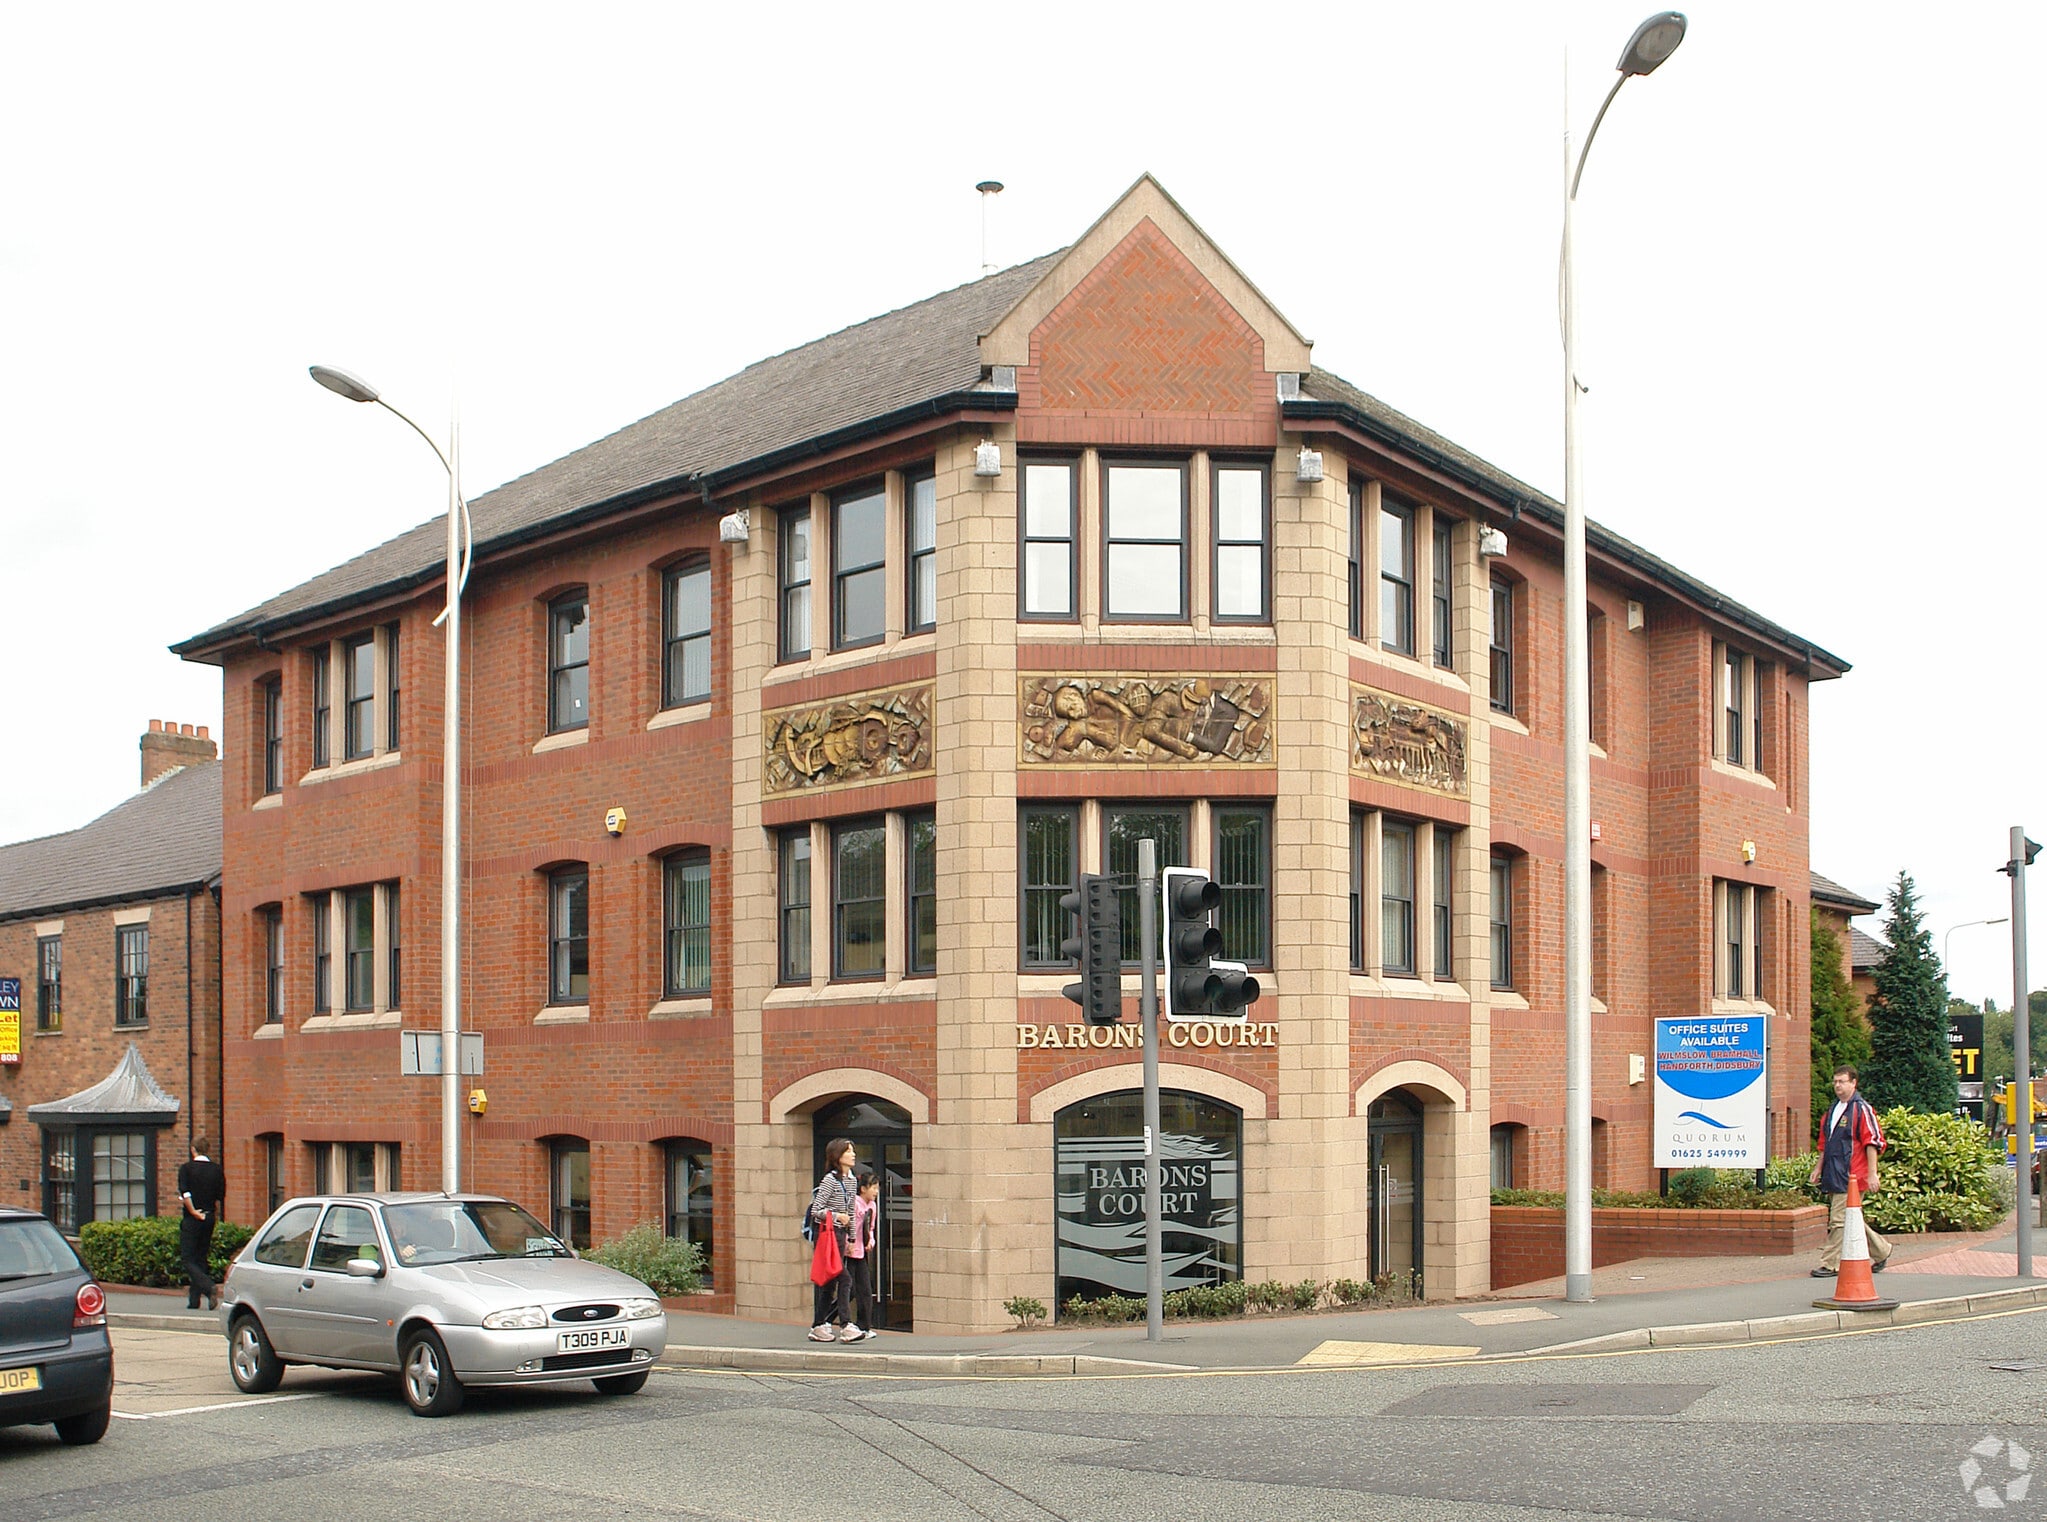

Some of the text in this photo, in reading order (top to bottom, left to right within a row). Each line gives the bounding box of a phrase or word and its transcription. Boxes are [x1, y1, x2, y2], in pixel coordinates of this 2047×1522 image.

[0, 981, 19, 993] EY
[1168, 1022, 1279, 1047] COURT
[1669, 1023, 1749, 1035] OFFICE SUITES
[1680, 1036, 1739, 1047] AVAILABLE
[1672, 1133, 1746, 1144] QUORUM
[1671, 1149, 1747, 1158] 01625 549999
[562, 1330, 627, 1349] T309 PJA
